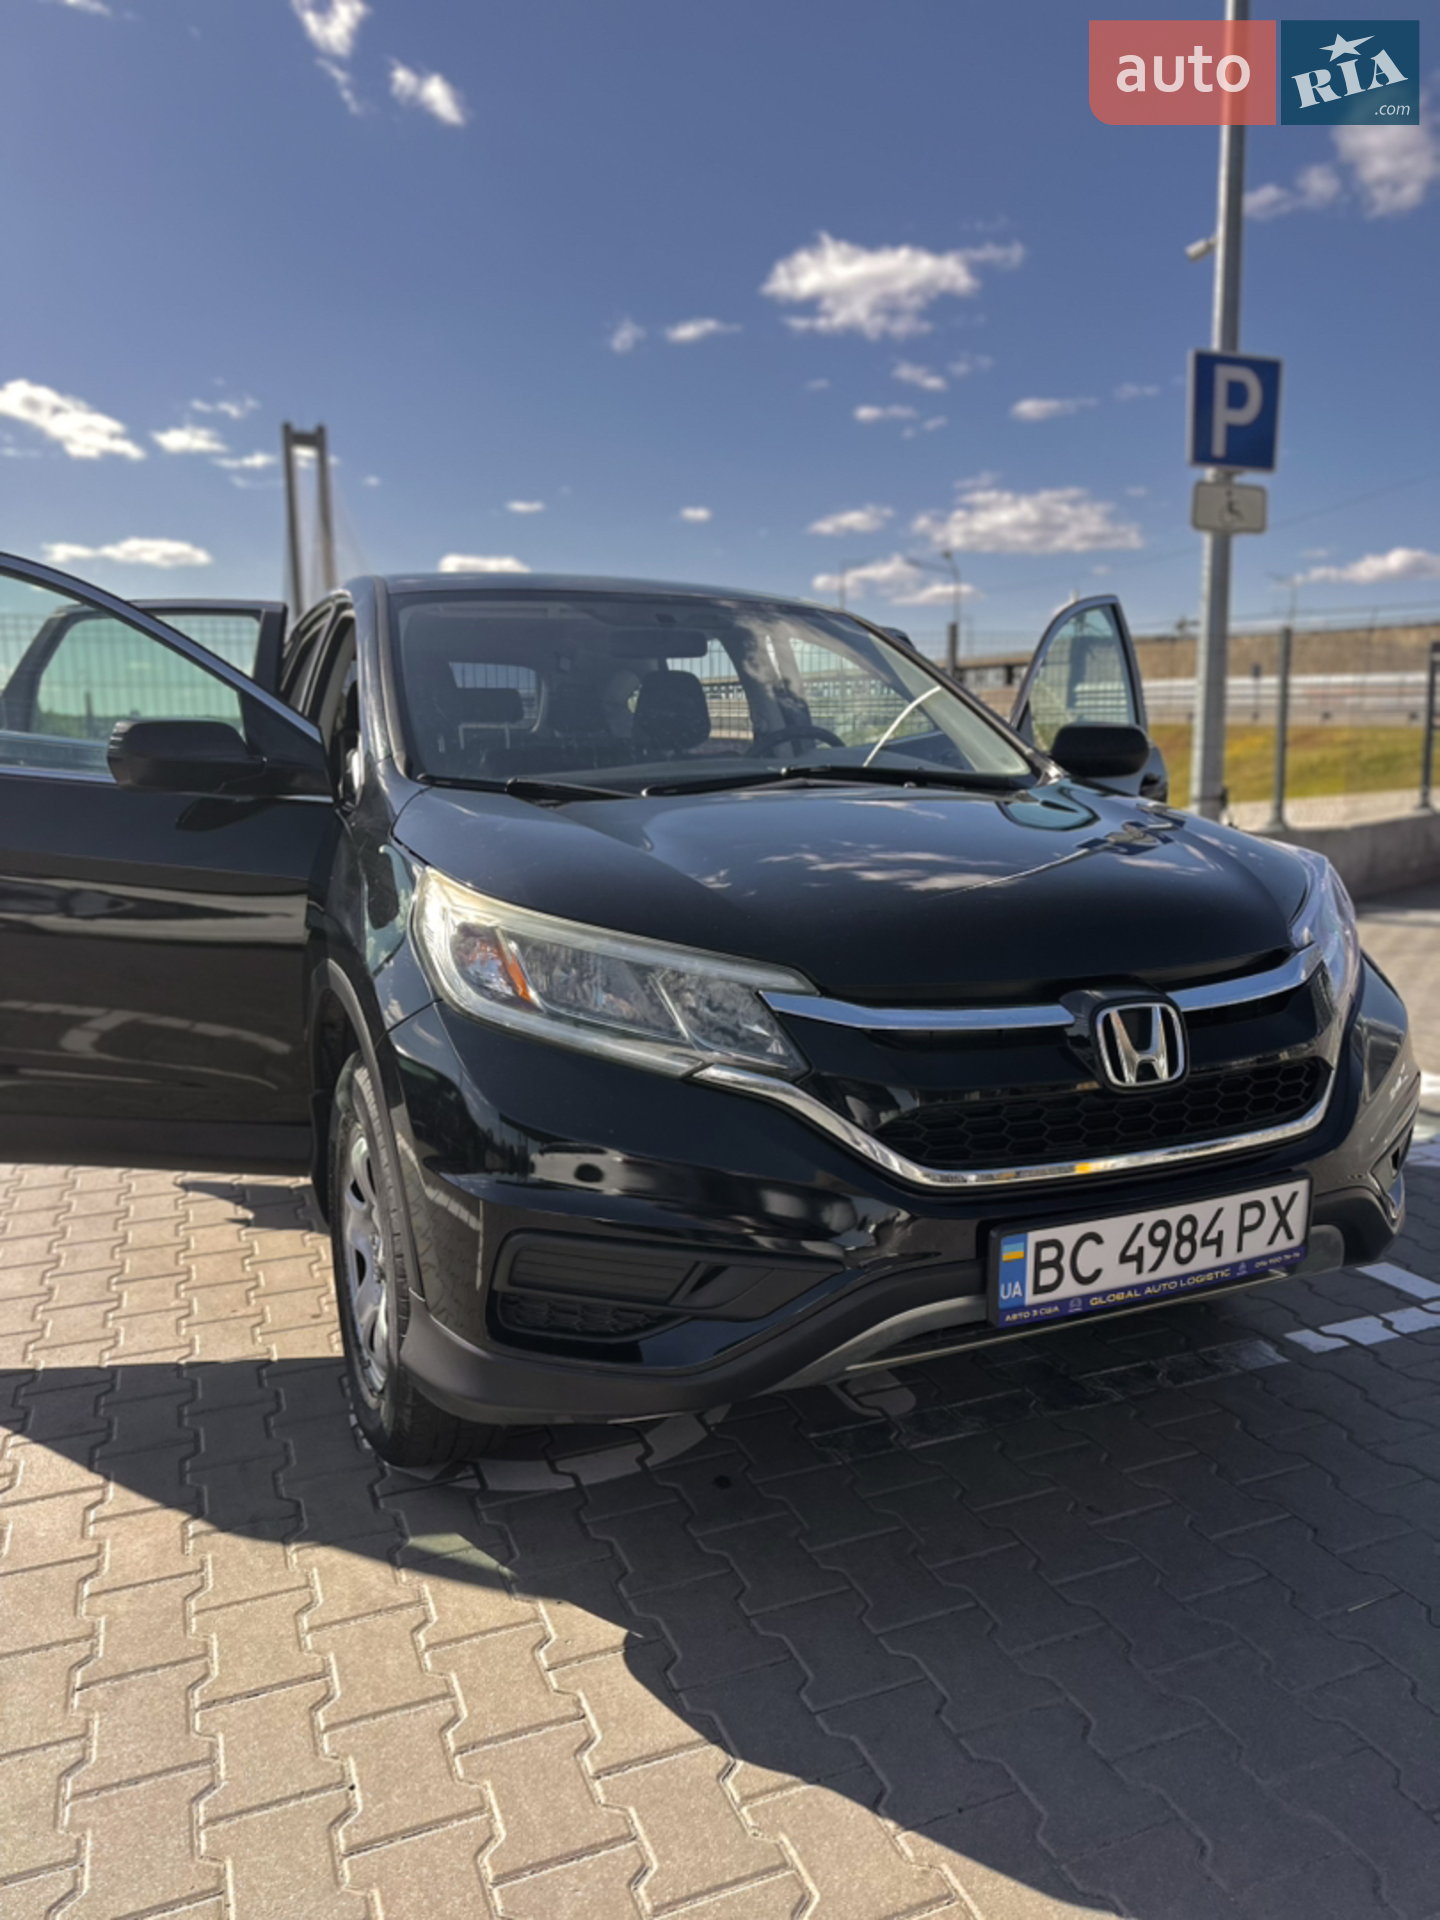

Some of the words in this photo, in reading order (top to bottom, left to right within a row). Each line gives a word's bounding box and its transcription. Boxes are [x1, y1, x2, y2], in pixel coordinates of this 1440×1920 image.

[1211, 363, 1264, 458] P
[1033, 1231, 1105, 1295] BC
[1118, 1206, 1224, 1275] 4984
[1236, 1191, 1299, 1253] PX
[1000, 1281, 1022, 1299] UA
[1089, 1289, 1141, 1306] GLOBAL
[1144, 1280, 1177, 1295] AUTO
[1180, 1268, 1231, 1288] LOGISTIC
